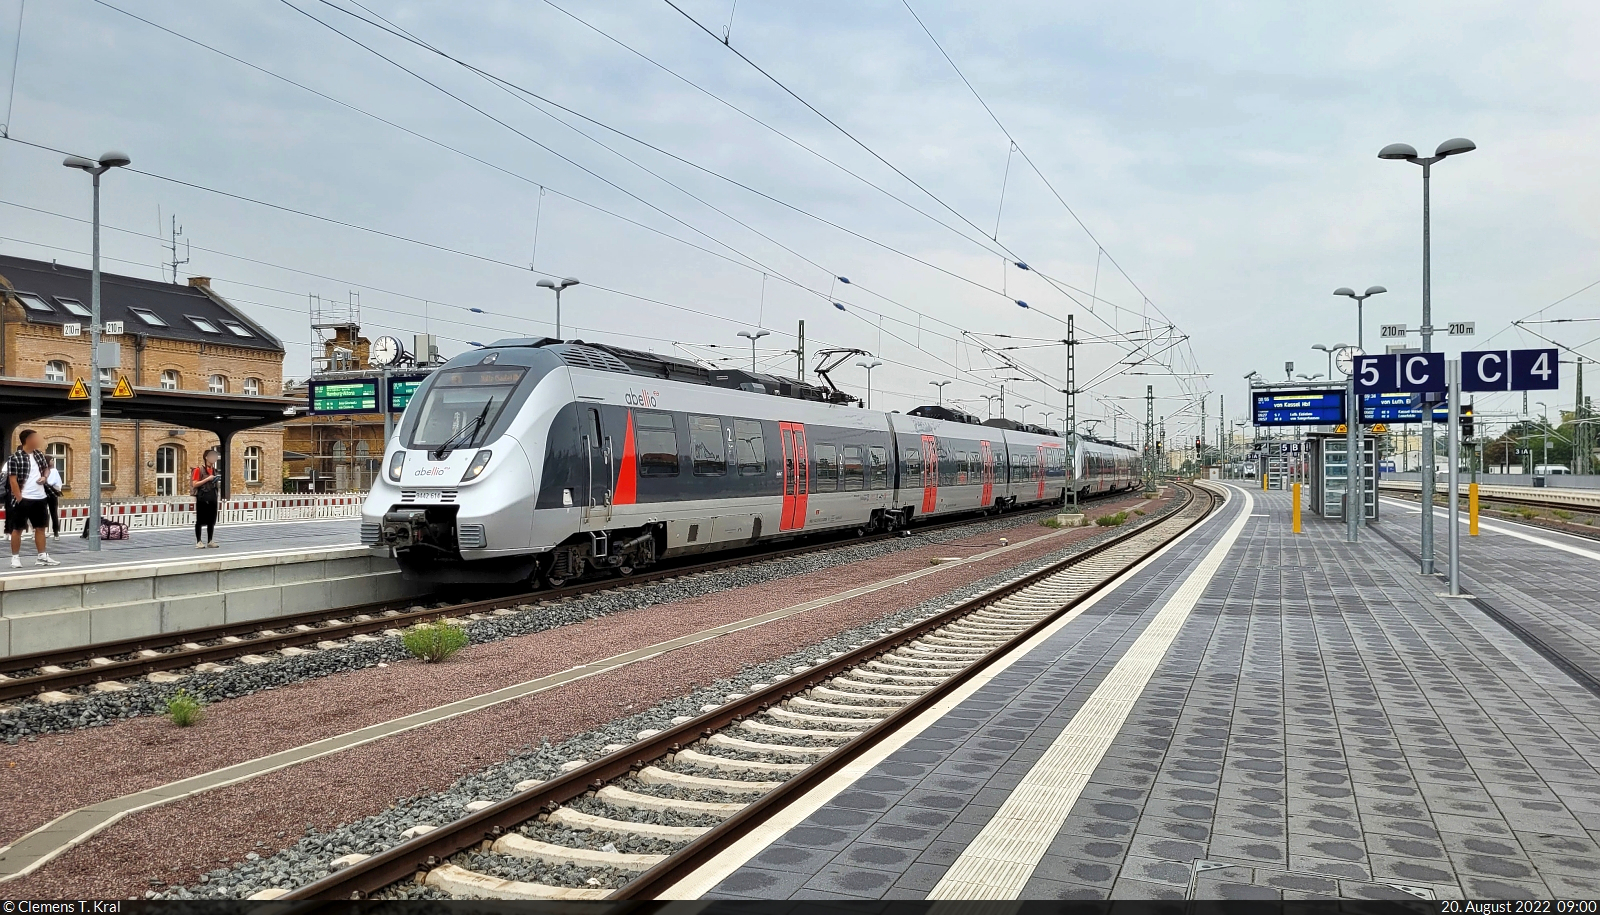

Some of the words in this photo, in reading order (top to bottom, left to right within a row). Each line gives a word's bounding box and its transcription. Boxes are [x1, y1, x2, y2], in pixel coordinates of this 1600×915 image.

[64, 326, 74, 334] 210
[107, 323, 117, 332] 210
[1382, 326, 1396, 336] 210
[1449, 324, 1465, 334] 210
[1360, 358, 1380, 386] 5
[1405, 356, 1430, 385] C
[1477, 354, 1502, 383] C
[1530, 352, 1552, 381] 4
[624, 388, 657, 408] abellio
[726, 428, 732, 442] 2
[414, 466, 444, 476] abellio
